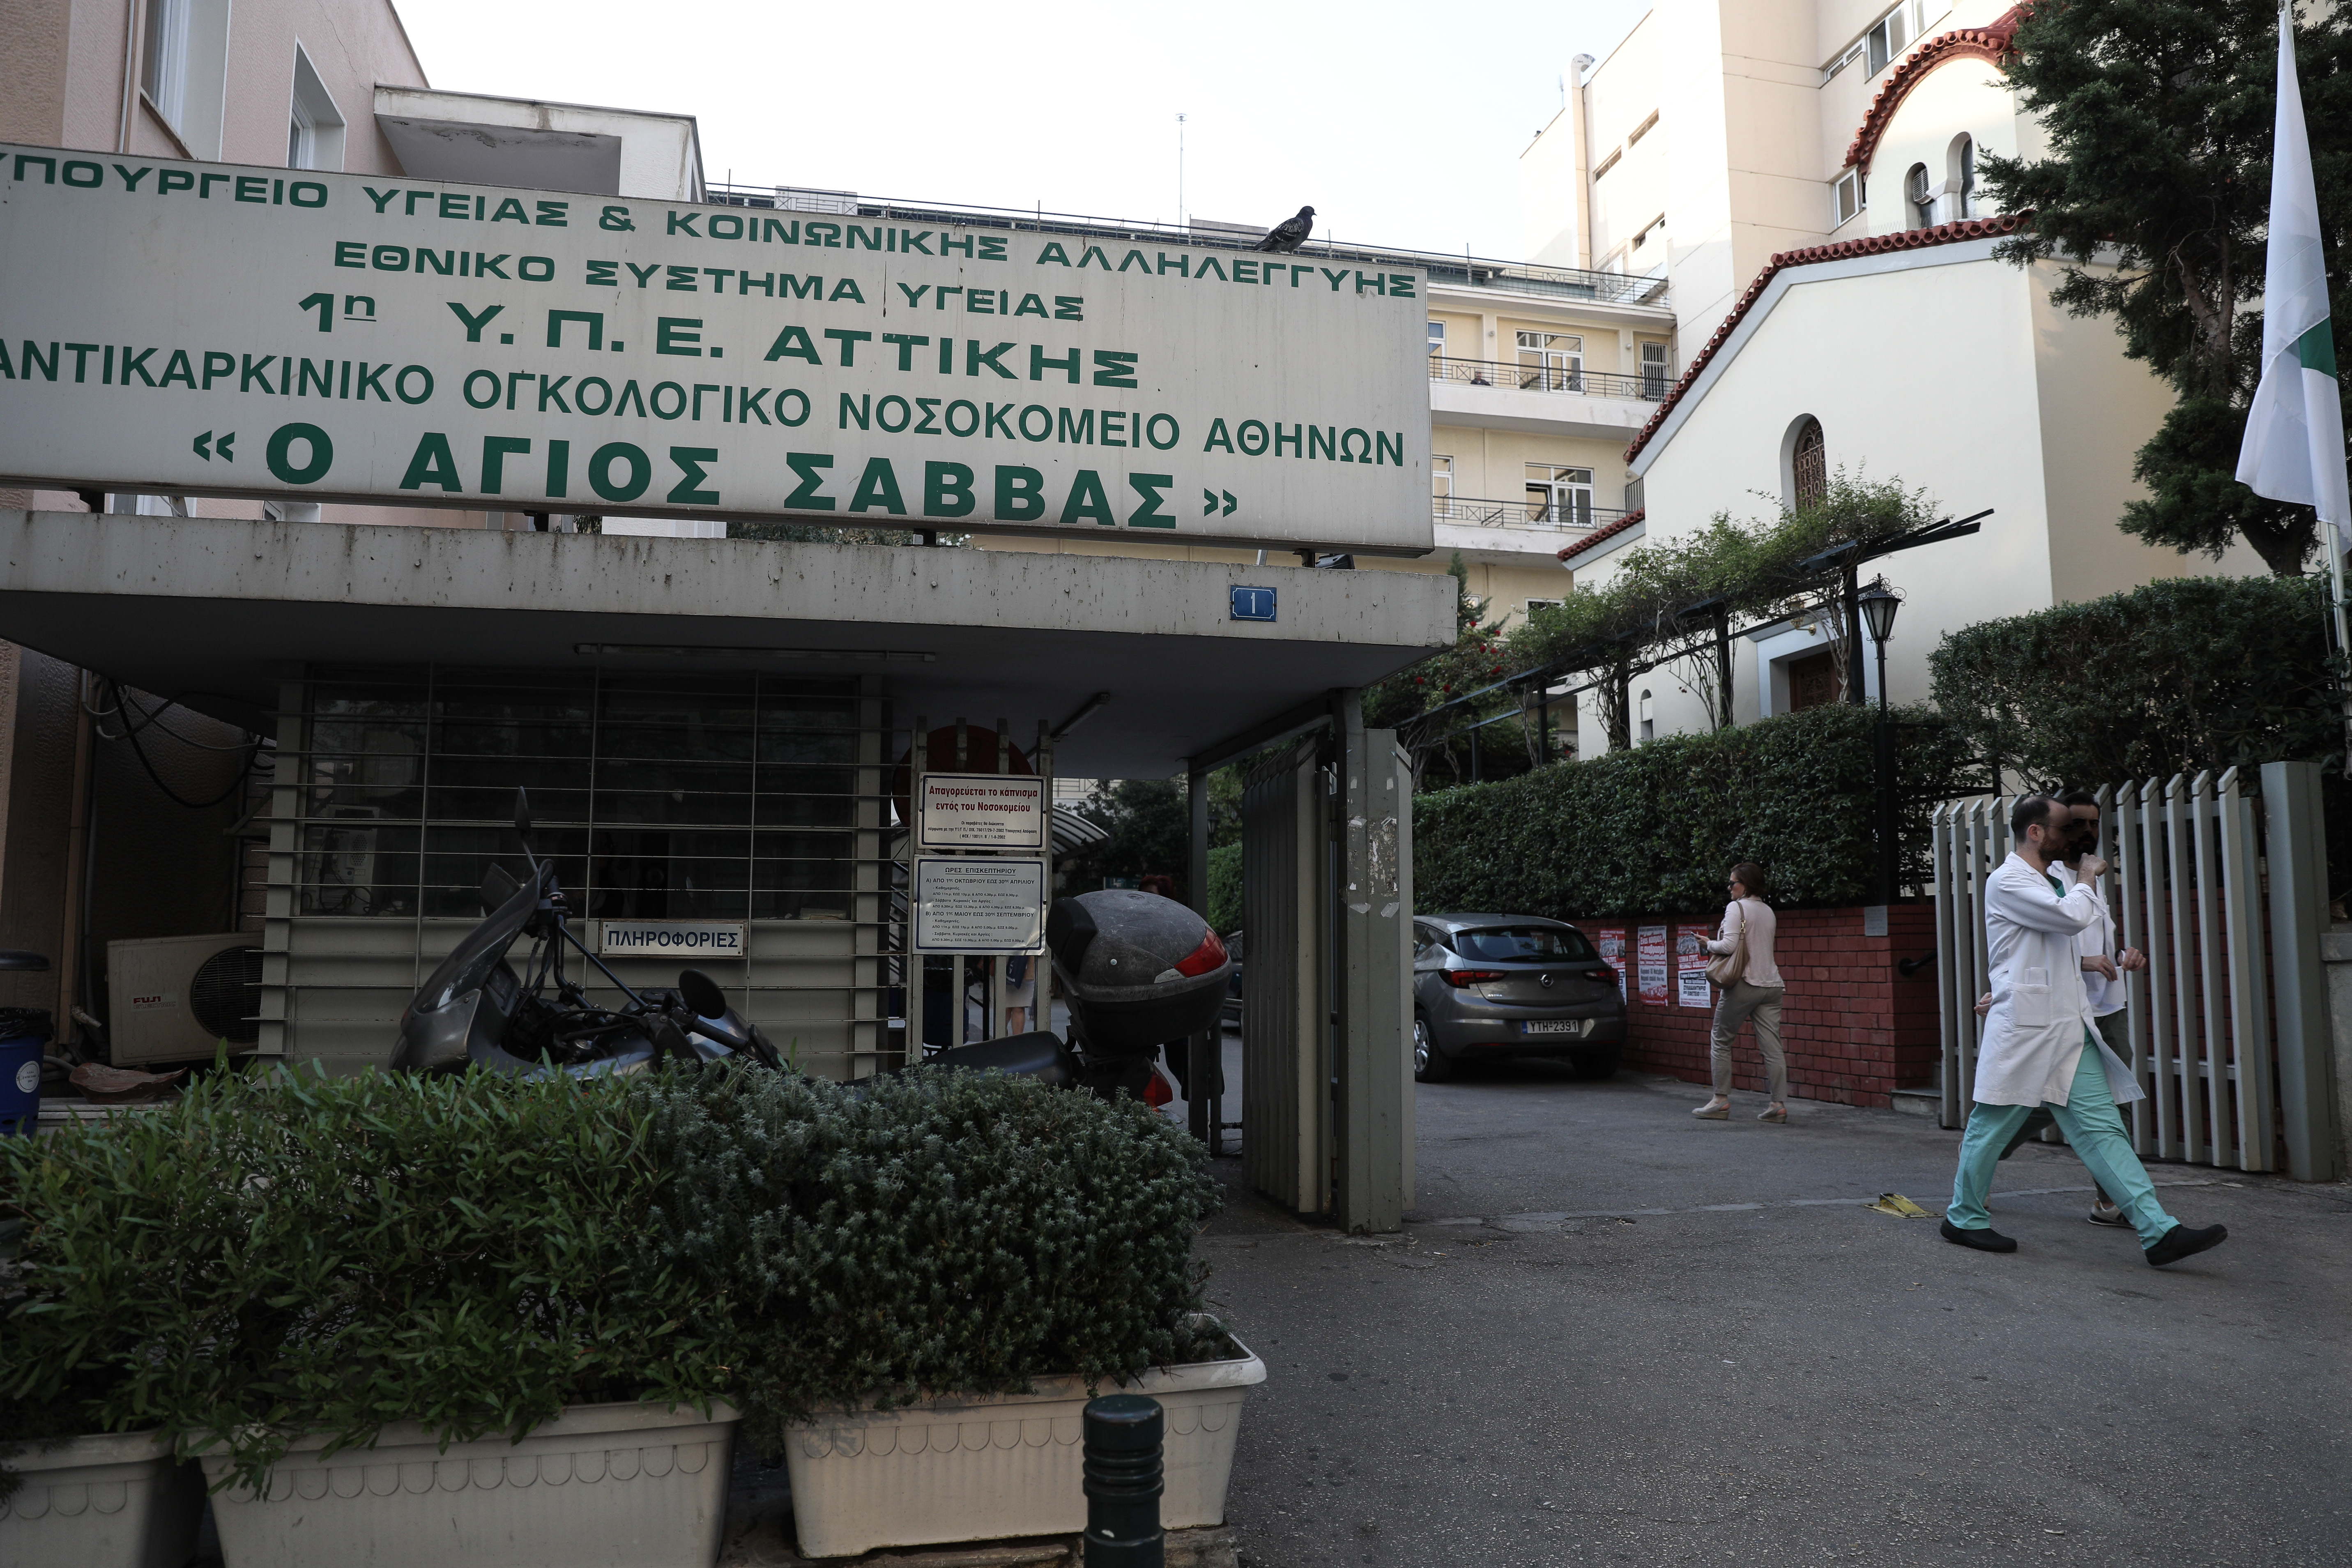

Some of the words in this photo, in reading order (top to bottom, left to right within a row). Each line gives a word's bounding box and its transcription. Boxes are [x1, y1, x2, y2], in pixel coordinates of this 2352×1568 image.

[0, 152, 328, 208] ΠΟΥΡΓΕΙΟ
[364, 187, 569, 227] ΥΓΕΙΑΣ
[599, 206, 636, 232] &
[667, 211, 1008, 261] ΚΟΙΝΩΝΙΚΗΣ
[1037, 242, 1415, 298] ΑΛΛΗΛΕΓΓΥΗΣ
[335, 242, 555, 282] ΕΘΝΙΚΟ
[586, 260, 865, 304] ΣΥΣΤΗΜΑ
[898, 283, 1084, 321] ΥΓΕΙΑΣ
[764, 326, 1138, 389] ΑΤΤΙΚΗΣ
[464, 370, 811, 427] ΟΓΚΟΛΟΓΙΚΟ
[840, 393, 1180, 450] ΝΟΣΟΚΟΜΕΙΟ
[1204, 418, 1403, 467] ΑΘΗΝΩΝ
[400, 433, 720, 505] ΑΓΙΟΣ
[1251, 592, 1255, 614] 1
[929, 785, 986, 798] Απαγορεύεται
[1000, 786, 1038, 799] κάπνισμα
[936, 800, 959, 813] εντός
[978, 801, 1031, 814] Νοσοκομείου
[608, 930, 738, 948] ΠΛΗΡΟΦΟΡΙΕΣ
[133, 1001, 176, 1009] ELECTRIC
